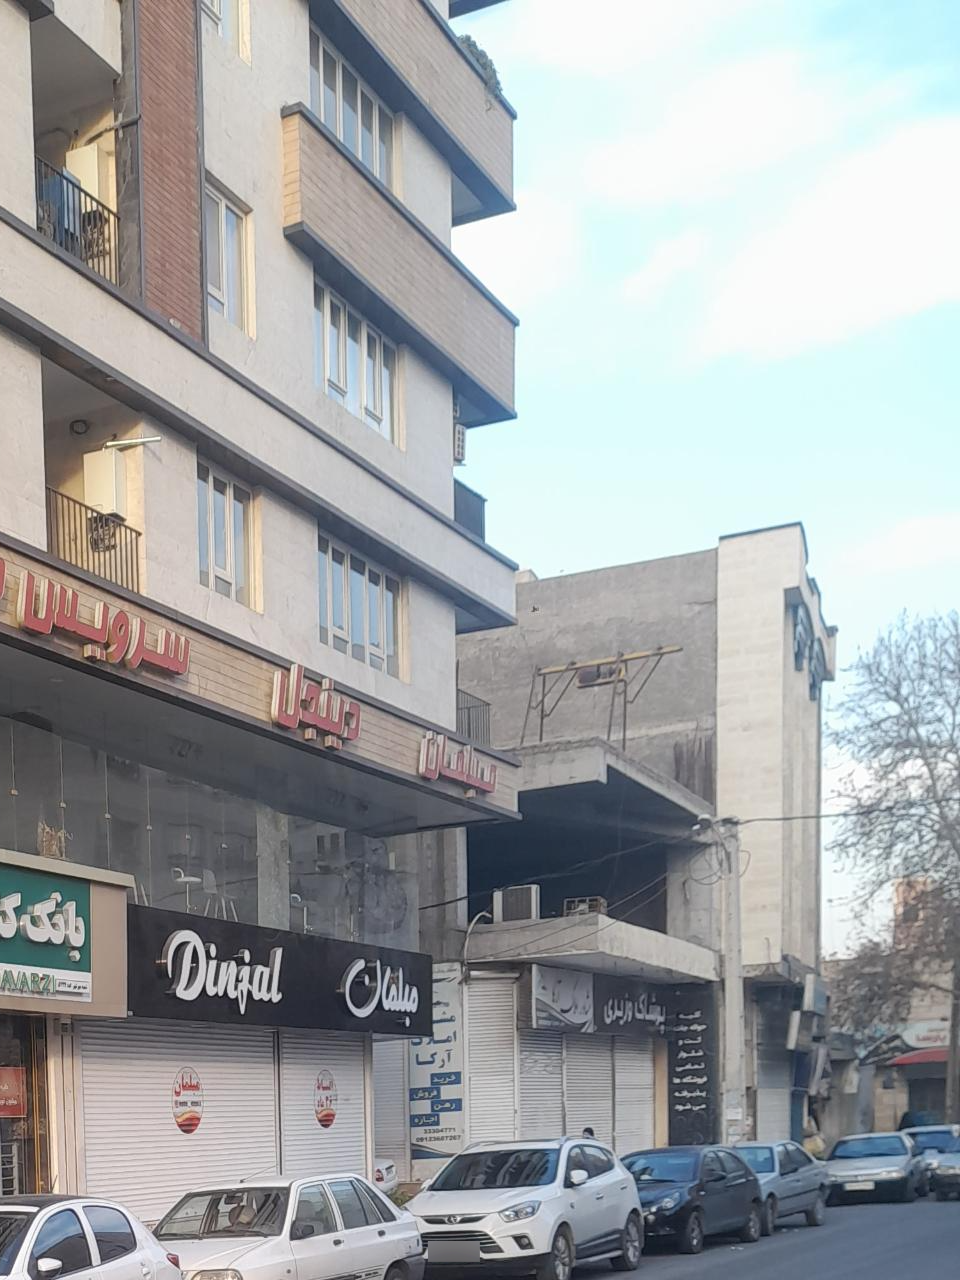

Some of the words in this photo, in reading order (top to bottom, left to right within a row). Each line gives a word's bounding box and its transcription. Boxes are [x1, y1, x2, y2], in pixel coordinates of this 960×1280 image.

[17, 570, 191, 674] سرویس
[271, 664, 361, 750] دینجل
[20, 892, 86, 962] بانک
[164, 929, 283, 1015] Dinjal
[344, 958, 419, 1027] مبلمان
[635, 992, 666, 1034] پوشاک
[415, 1049, 452, 1068] آرکا
[175, 1073, 200, 1097] مبلمان
[413, 1088, 437, 1099] فروش
[432, 1073, 456, 1084] خرید
[414, 1115, 438, 1125] اجاره
[434, 1102, 455, 1111] رهن
